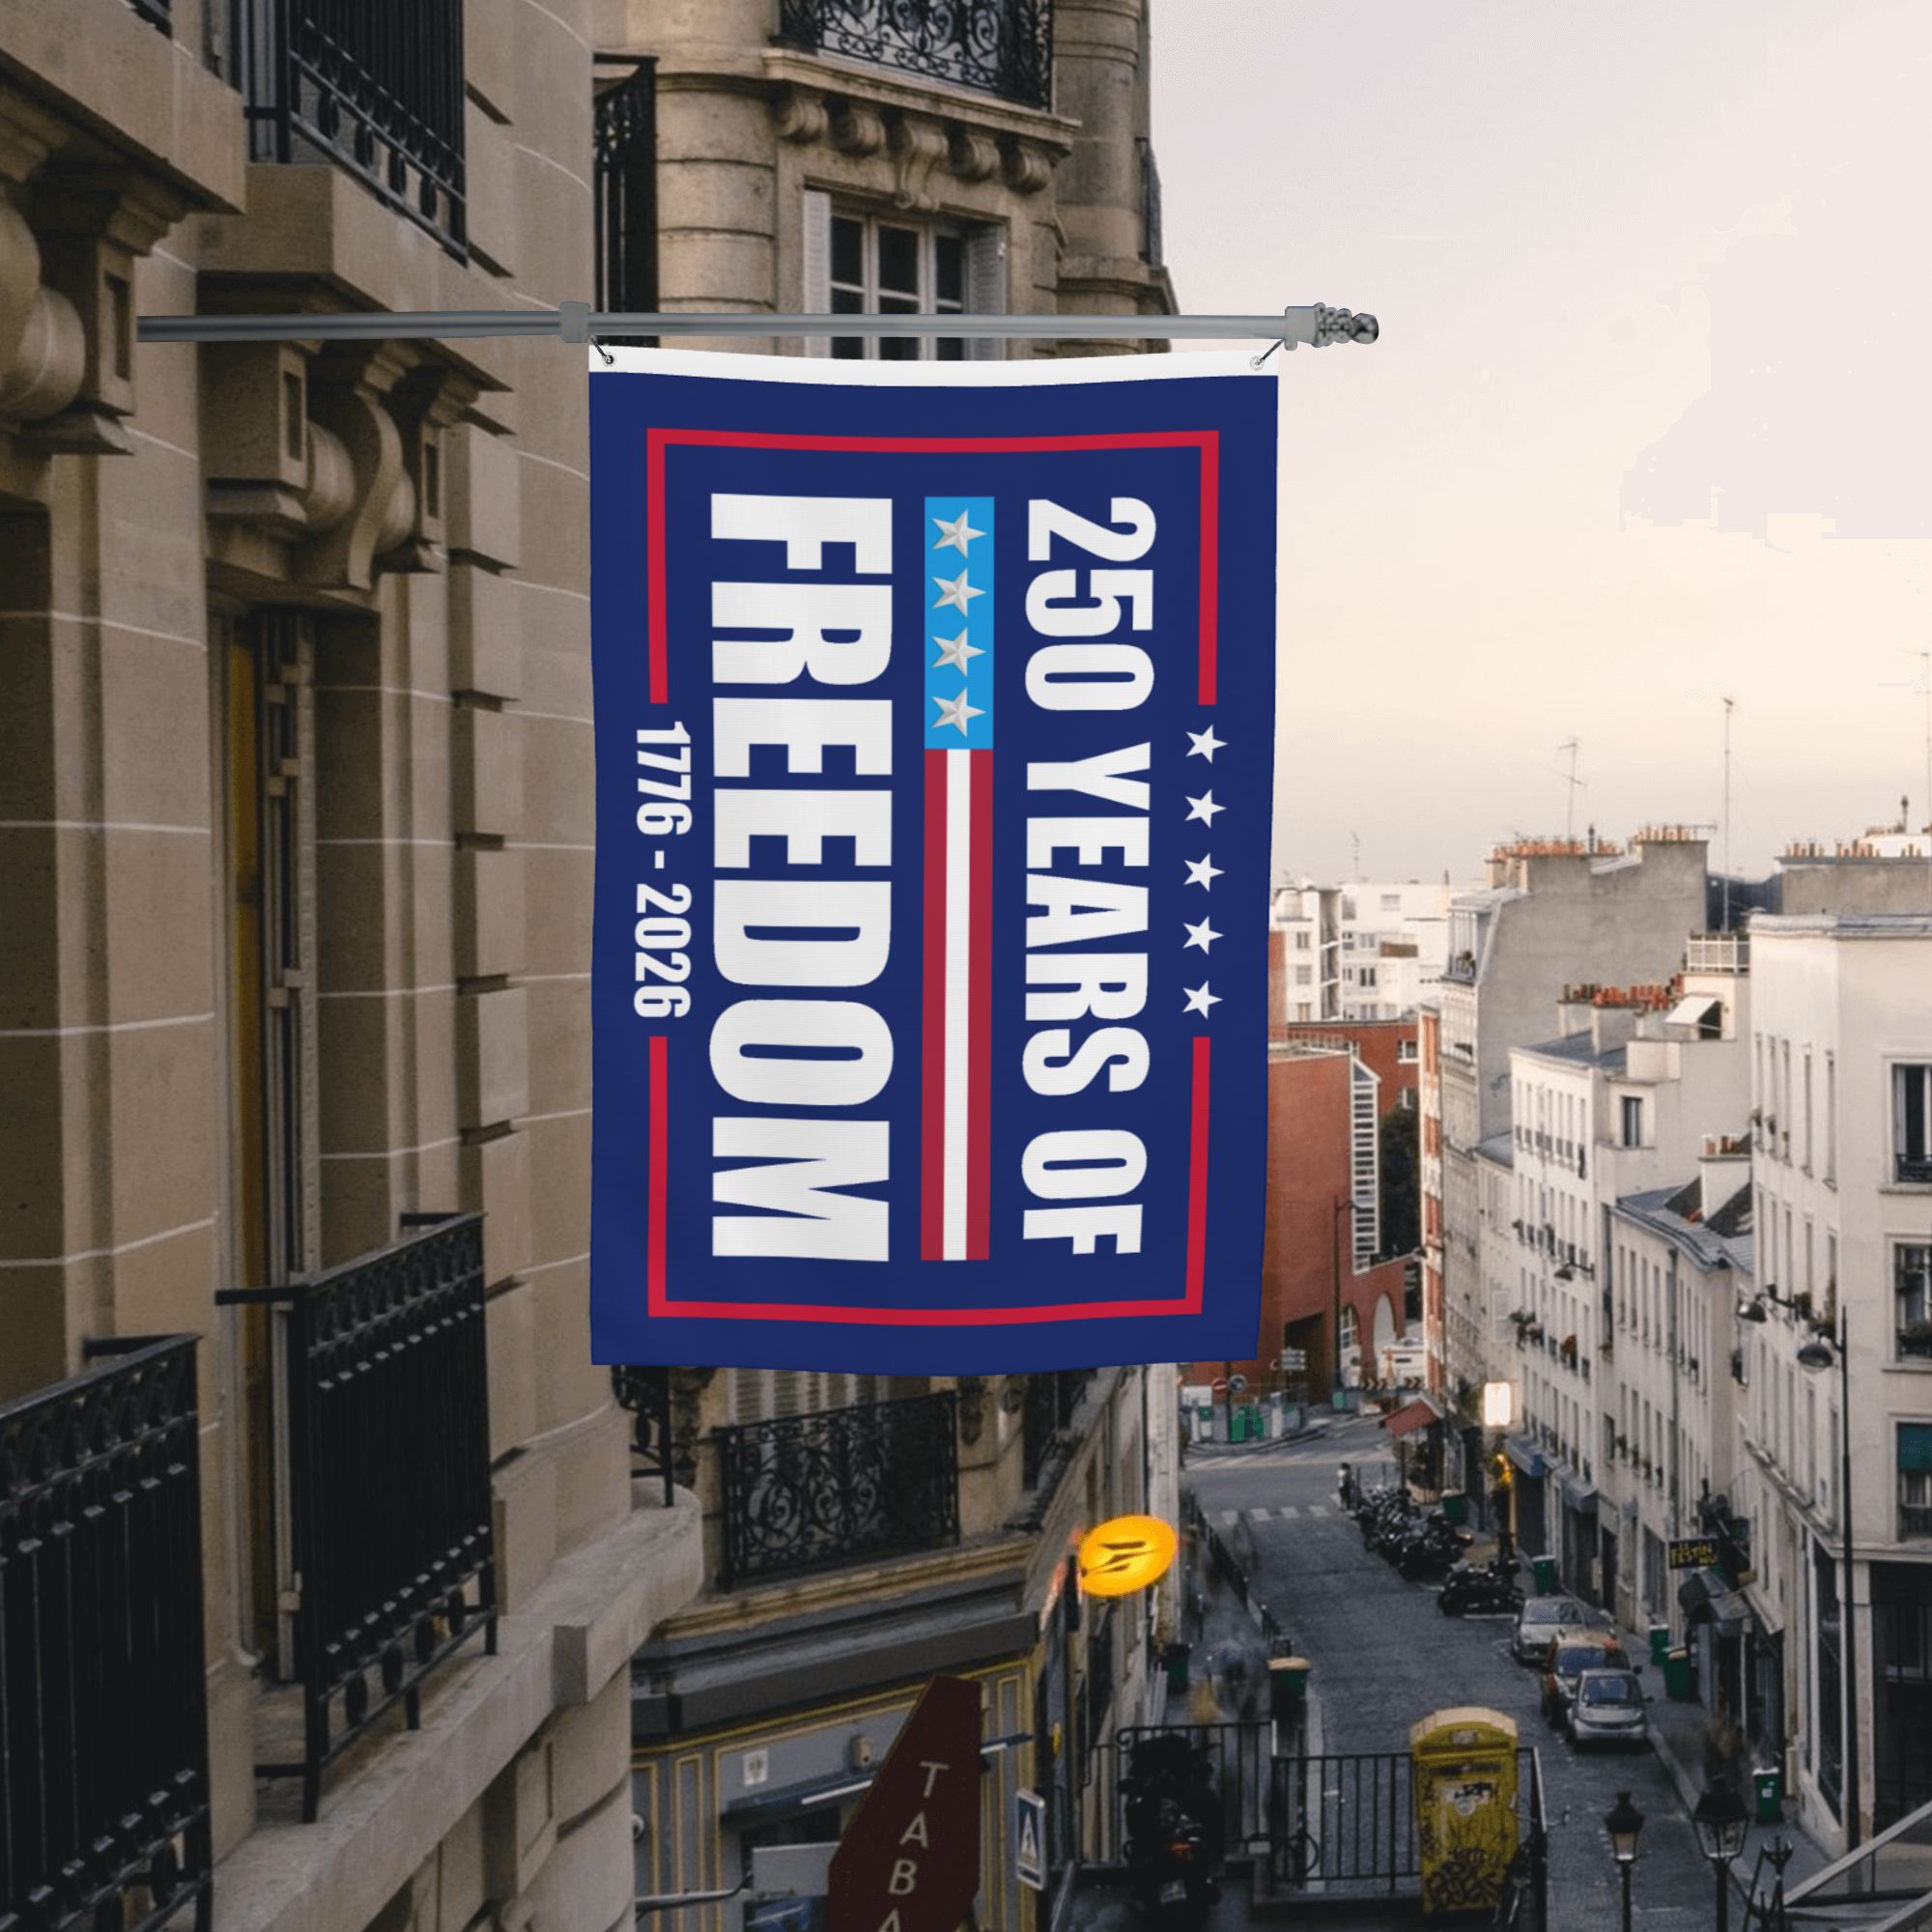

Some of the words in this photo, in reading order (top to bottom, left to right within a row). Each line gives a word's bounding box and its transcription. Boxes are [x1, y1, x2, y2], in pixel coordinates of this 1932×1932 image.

[1024, 497, 1156, 712] 250
[635, 721, 693, 837] 1776
[633, 883, 693, 1019] 2026
[708, 493, 895, 1263] FREEDOM
[1021, 741, 1151, 1096] YEARS
[1020, 1129, 1148, 1255] OF
